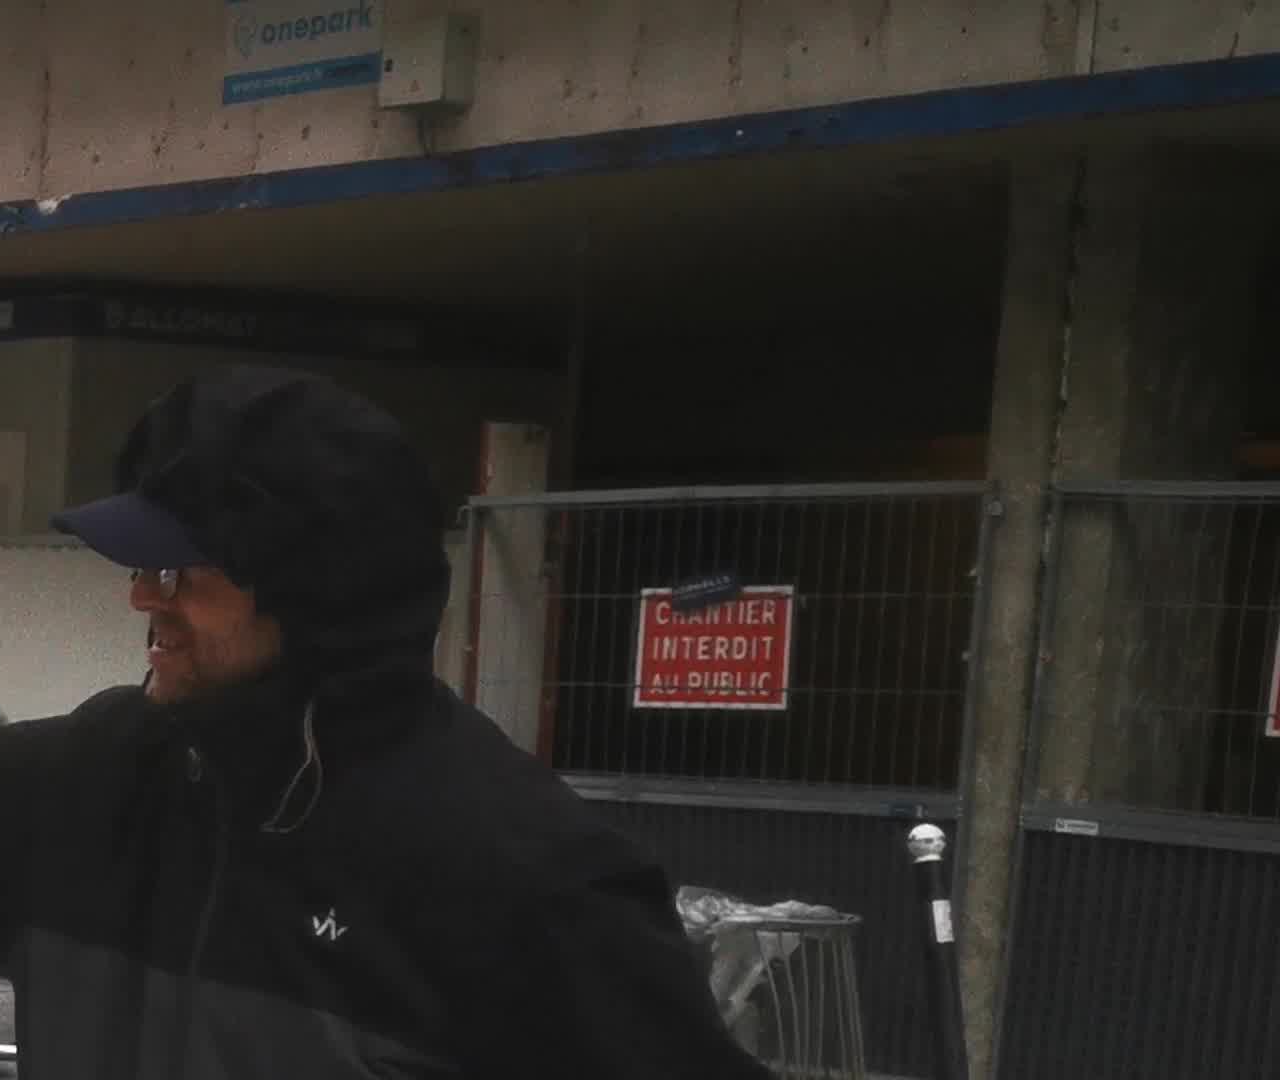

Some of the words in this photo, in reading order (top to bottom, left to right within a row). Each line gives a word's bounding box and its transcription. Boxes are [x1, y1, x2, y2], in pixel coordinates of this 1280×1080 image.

[261, 2, 372, 45] onepark
[652, 636, 774, 661] INTERDIT
[649, 673, 679, 696] AU
[687, 671, 772, 696] PUBLIC
